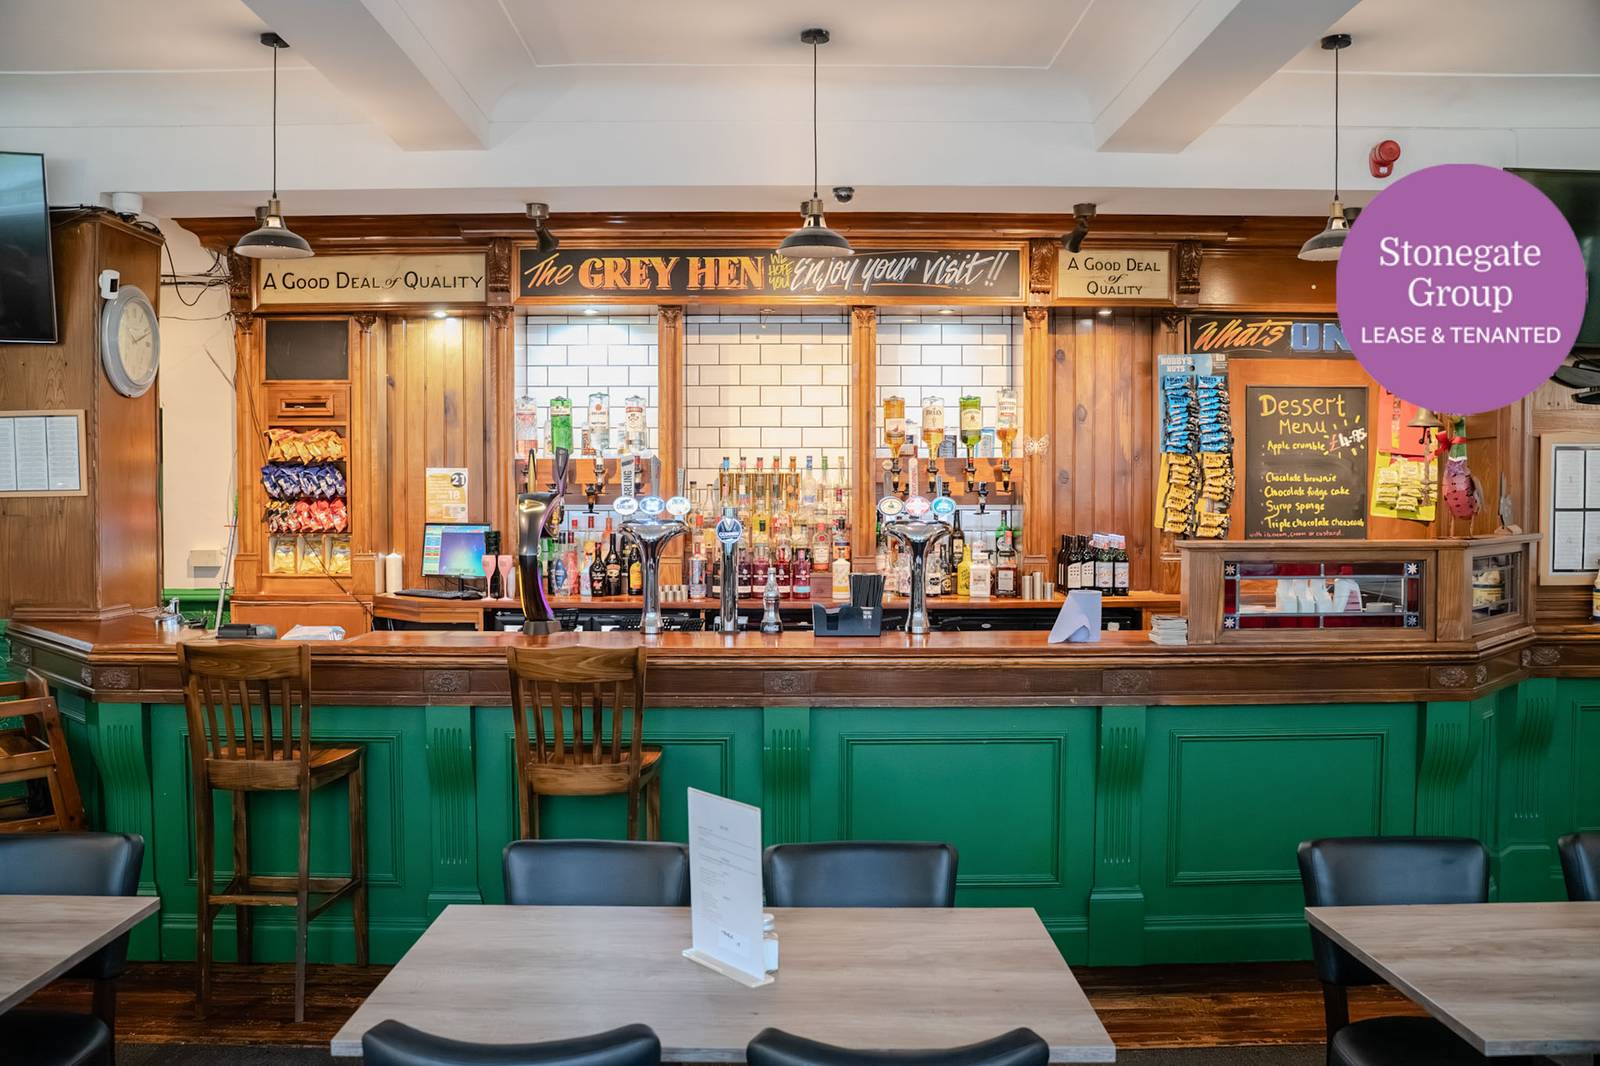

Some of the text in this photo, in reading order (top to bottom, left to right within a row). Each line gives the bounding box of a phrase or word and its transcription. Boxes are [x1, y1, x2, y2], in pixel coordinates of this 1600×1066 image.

[524, 253, 765, 290] The GREY HEN
[1067, 257, 1161, 272] A GOOD DEAL
[263, 272, 277, 290] A
[336, 271, 380, 290] DEAL
[381, 275, 401, 289] of
[404, 271, 484, 290] QUALITY
[790, 256, 859, 292] Enjoy
[861, 256, 918, 292] your
[1104, 273, 1129, 285] of
[768, 276, 790, 290] YOU
[1086, 280, 1143, 296] QUALITY
[1193, 319, 1294, 351] What's
[1258, 393, 1346, 417] Dessert
[1279, 418, 1328, 436] Menu
[1267, 440, 1326, 456] Apple crumble
[451, 474, 465, 486] 21
[623, 470, 634, 500] ARLING
[1265, 471, 1337, 483] Chocolate brownie
[1264, 485, 1351, 500] Chocolate fudge cake
[1265, 500, 1325, 516] Syrup sponge
[1264, 515, 1291, 532] Triple
[1292, 517, 1330, 529] chocolate
